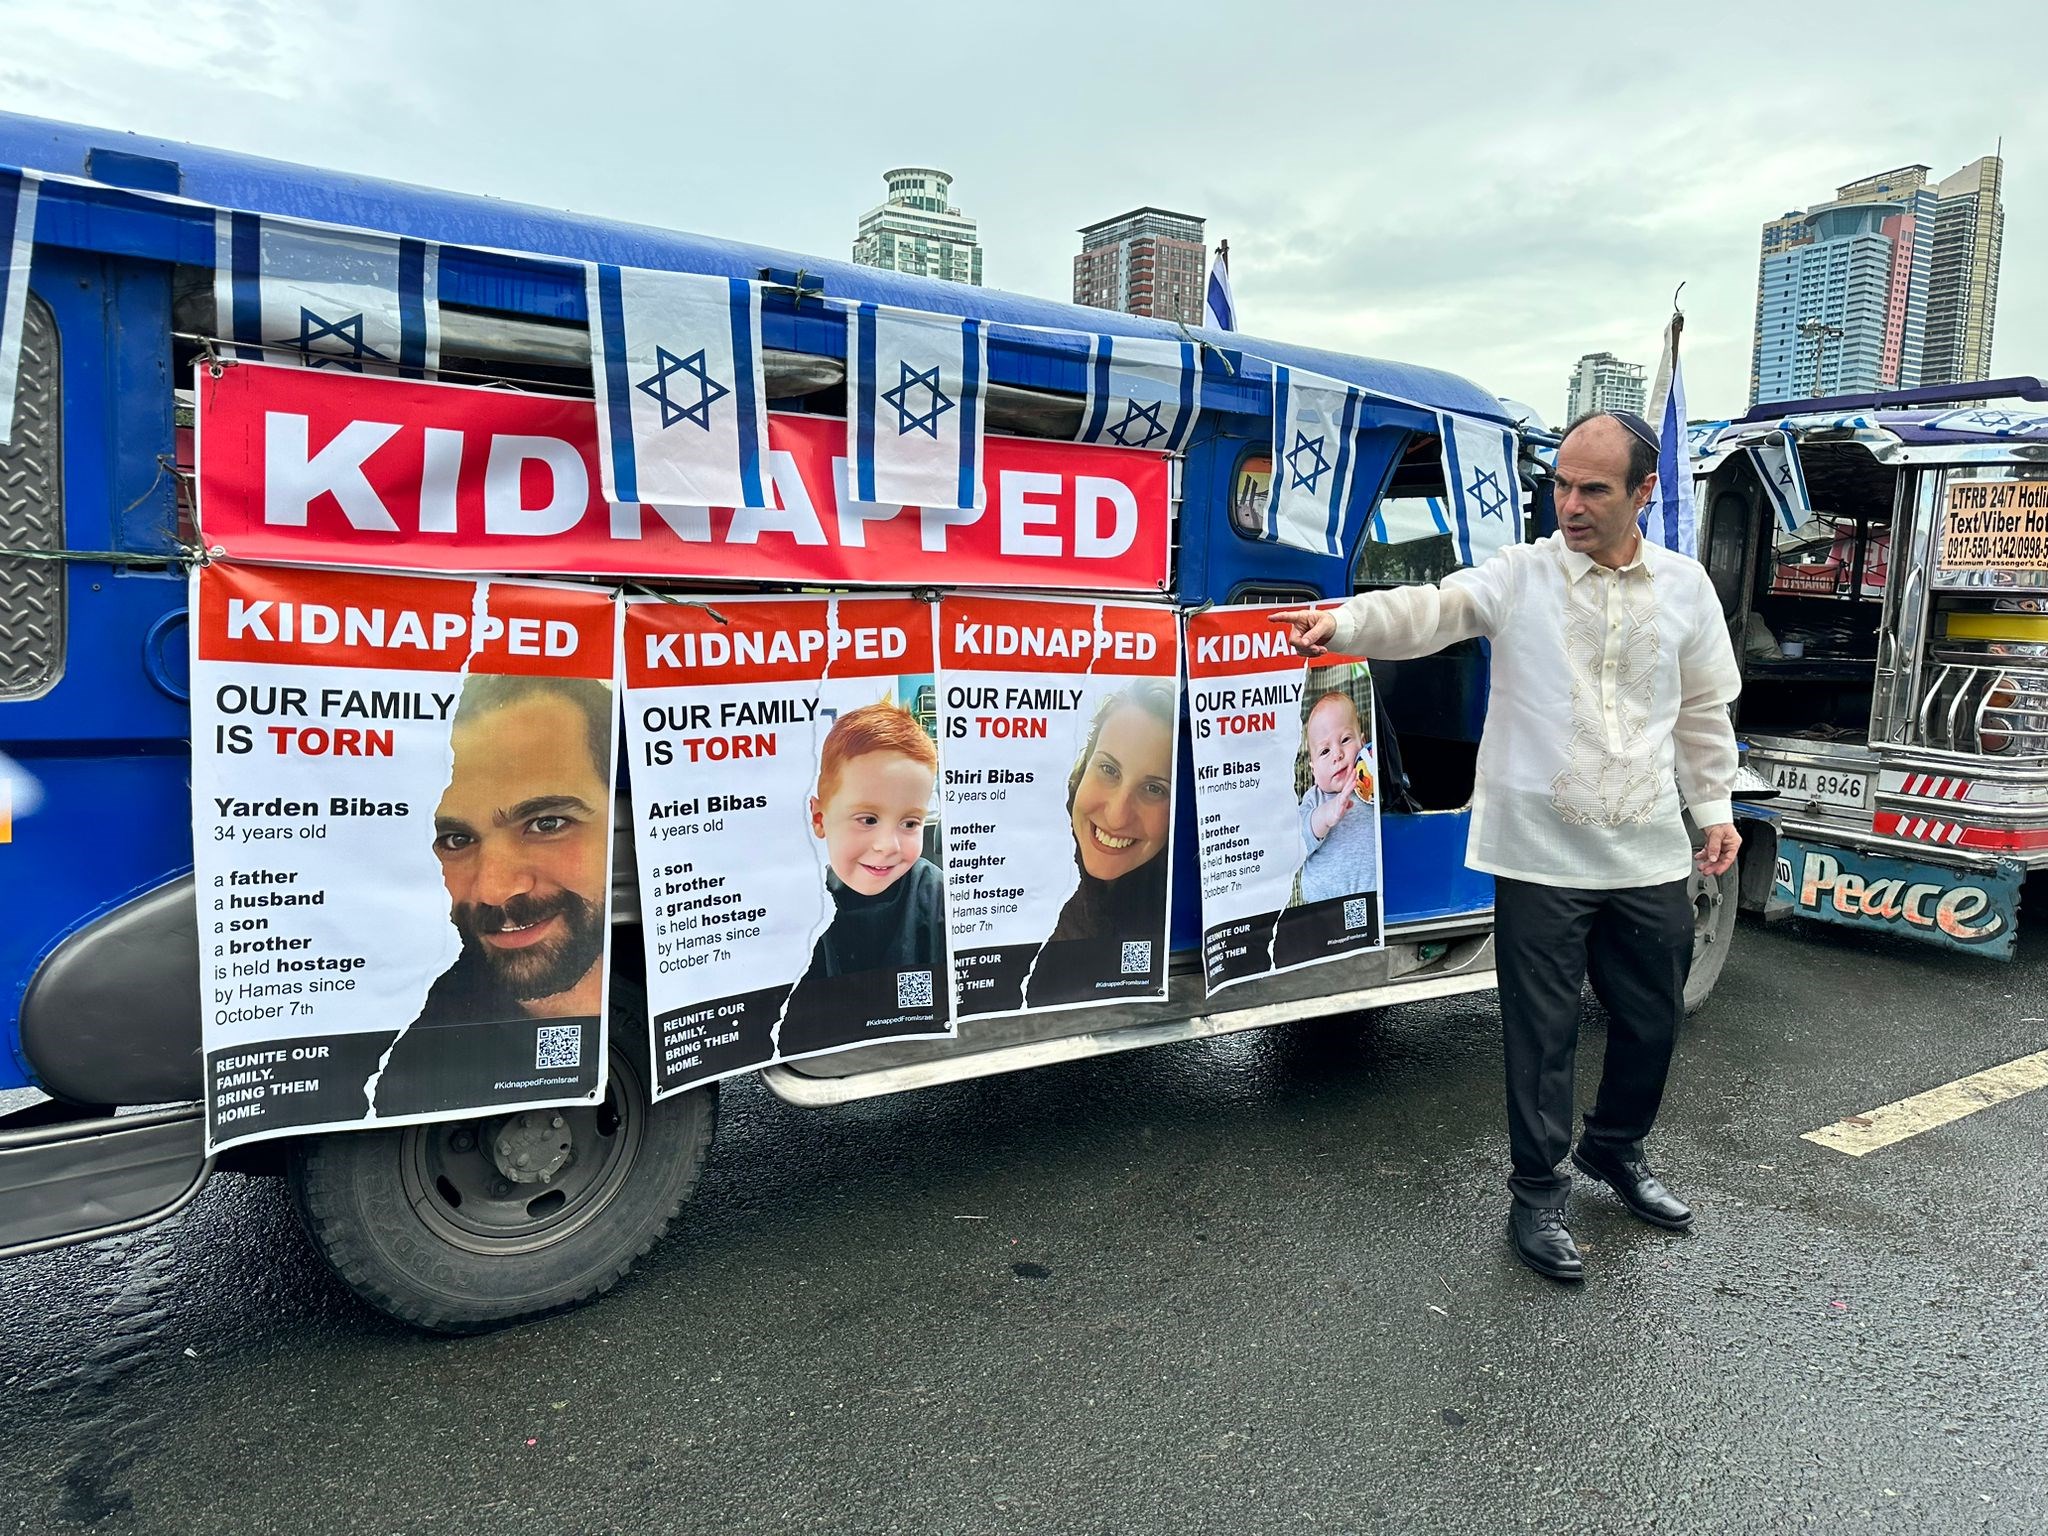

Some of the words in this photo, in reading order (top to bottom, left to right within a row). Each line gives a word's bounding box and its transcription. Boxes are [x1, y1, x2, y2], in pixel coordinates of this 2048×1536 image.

[1952, 486, 1987, 509] LTFRB
[1990, 486, 2016, 508] 24/7
[1950, 510, 2022, 534] Text/Viber
[1986, 560, 2034, 568] Passenger's
[227, 598, 579, 657] KIDNAPPED
[646, 626, 907, 669] KIDNAPPED
[955, 623, 1156, 660] KIDNAPPED
[216, 685, 308, 716] OUR
[321, 689, 455, 720] FAMILY
[947, 687, 999, 709] OUR
[1006, 688, 1083, 710] FAMILY
[1195, 691, 1235, 713] OUR
[1242, 683, 1302, 709] FAMILY
[643, 705, 711, 732] OUR
[720, 698, 819, 727] FAMILY
[1196, 718, 1210, 739] IS
[1216, 712, 1276, 736] TORN
[946, 716, 967, 738] IS
[975, 717, 1048, 738] TORN
[216, 725, 253, 754] IS
[268, 726, 393, 756] TORN
[646, 740, 673, 766] IS
[683, 733, 776, 762] TORN
[945, 770, 982, 784] Shiri
[987, 769, 1034, 784] Bibas
[1198, 765, 1219, 780] Kfir
[1223, 761, 1261, 776] Bibas
[1207, 781, 1237, 793] months
[1240, 777, 1260, 789] baby
[1776, 770, 1807, 791] ABA
[1817, 775, 1861, 797] 8946
[649, 799, 699, 820] Ariel
[707, 793, 767, 813] Bibas
[957, 791, 987, 804] years
[990, 789, 1006, 800] old
[214, 798, 319, 817] Yarden
[330, 798, 409, 816] Bibas
[950, 822, 996, 835] mother
[1205, 813, 1221, 824] son
[214, 825, 235, 841] 34
[242, 827, 293, 843] years
[300, 824, 326, 839] old
[650, 827, 657, 839] 4
[662, 824, 699, 841] years
[703, 819, 724, 833] old
[1205, 824, 1240, 839] brother
[950, 840, 977, 851] wife
[1206, 838, 1250, 856] grandson
[949, 855, 1006, 869] daughter
[1224, 849, 1264, 864] hostage
[214, 875, 224, 887] a
[230, 869, 298, 886] father
[653, 867, 660, 878] a
[664, 862, 693, 876] son
[949, 873, 984, 885] sister
[1210, 869, 1237, 882] Hamas
[1239, 864, 1261, 876] since
[654, 886, 661, 897] a
[665, 875, 725, 896] brother
[950, 889, 970, 902] held
[973, 887, 1025, 899] hostage
[1800, 851, 2003, 940] Peace
[214, 898, 224, 911] a
[230, 891, 325, 909] husband
[656, 905, 663, 917] a
[667, 892, 742, 917] grandson
[952, 906, 988, 918] Hamas
[991, 903, 1018, 914] since
[214, 921, 224, 933] a
[230, 916, 268, 932] son
[656, 923, 666, 936] is
[670, 916, 698, 933] held
[702, 907, 767, 928] hostage
[979, 920, 993, 931] 7th
[1233, 924, 1251, 935] OUR
[214, 944, 224, 956] a
[229, 936, 312, 955] brother
[658, 942, 672, 956] by
[676, 931, 722, 952] Hamas
[726, 925, 761, 941] since
[659, 952, 709, 974] October
[713, 949, 731, 962] 7th
[979, 954, 1001, 964] OUR
[1225, 946, 1247, 958] THEM
[215, 965, 226, 980] is
[233, 959, 270, 977] held
[277, 956, 366, 973] hostage
[215, 988, 233, 1005] by
[239, 983, 303, 999] Hamas
[309, 978, 355, 992] since
[966, 979, 994, 990] THEM
[216, 1005, 283, 1025] October
[290, 1002, 314, 1016] 7th
[663, 1009, 715, 1032] REUNITE
[718, 1002, 745, 1017] OUR
[664, 1026, 707, 1046] FAMILY.
[665, 1042, 701, 1062] BRING
[704, 1031, 739, 1048] THEM
[216, 1050, 287, 1073] REUNITE
[292, 1047, 329, 1060] OUR
[666, 1057, 703, 1076] HOME.
[216, 1068, 274, 1090] FAMILY.
[494, 1076, 578, 1089] #KidnappedFromIsrael
[218, 1086, 265, 1108] BRING
[270, 1079, 319, 1096] THEM
[218, 1103, 265, 1125] HOME.
